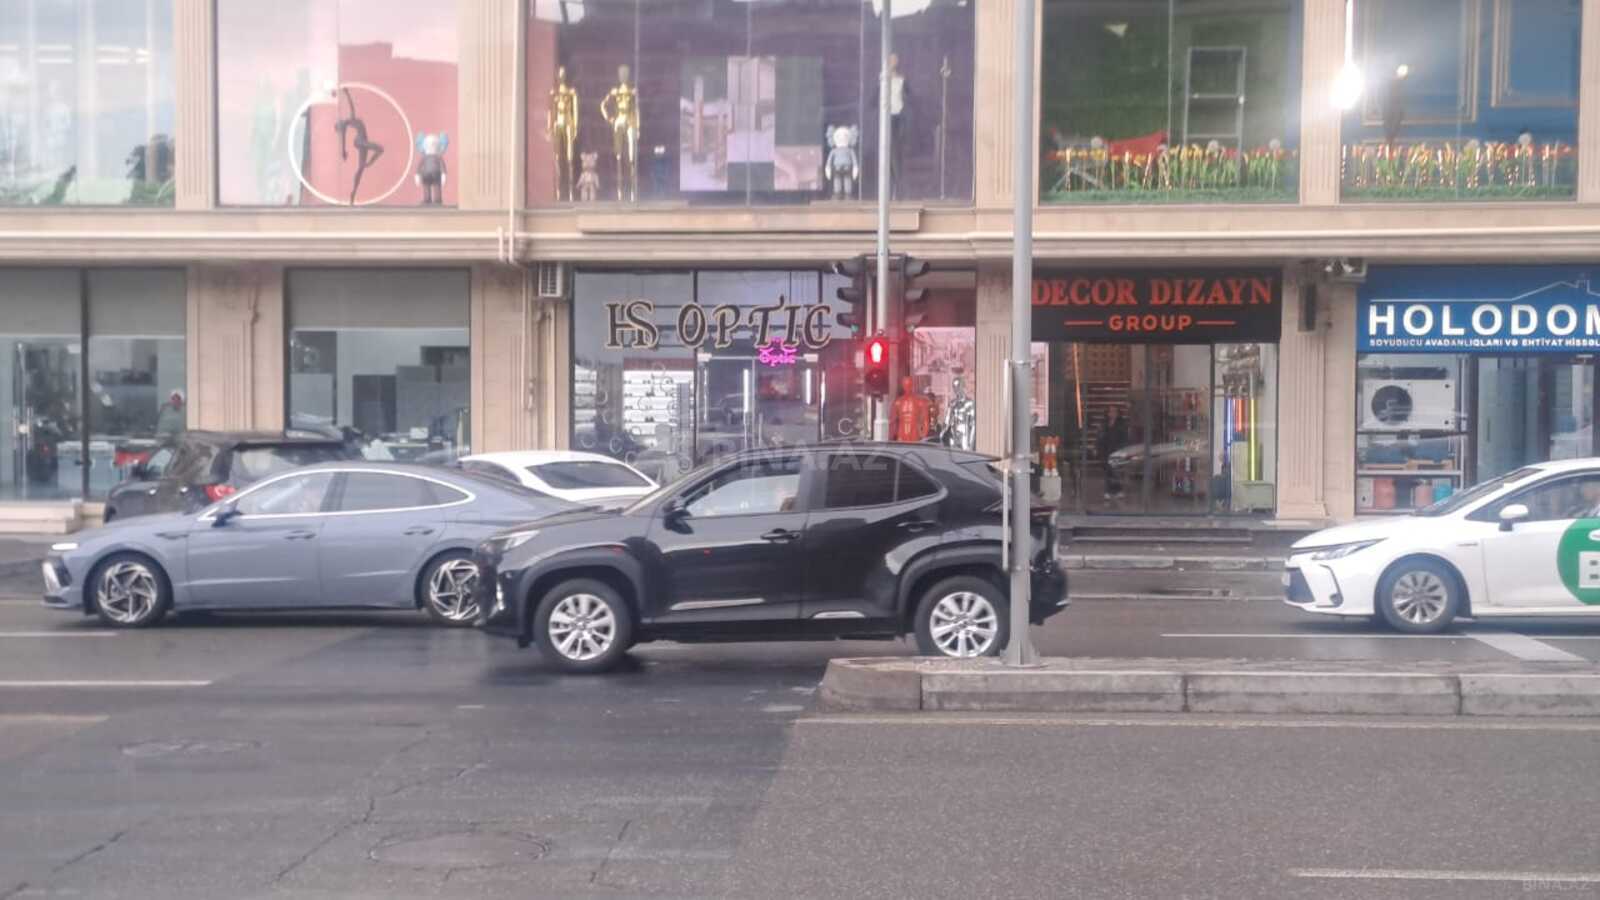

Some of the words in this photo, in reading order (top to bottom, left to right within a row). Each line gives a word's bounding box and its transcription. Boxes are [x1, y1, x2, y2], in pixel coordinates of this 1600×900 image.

[1031, 279, 1137, 305] DECOR
[1150, 278, 1272, 305] DIZAYN
[677, 294, 832, 349] OPTIC
[1108, 314, 1192, 331] GROUP
[1424, 338, 1502, 347] AVADANLIQLARI
